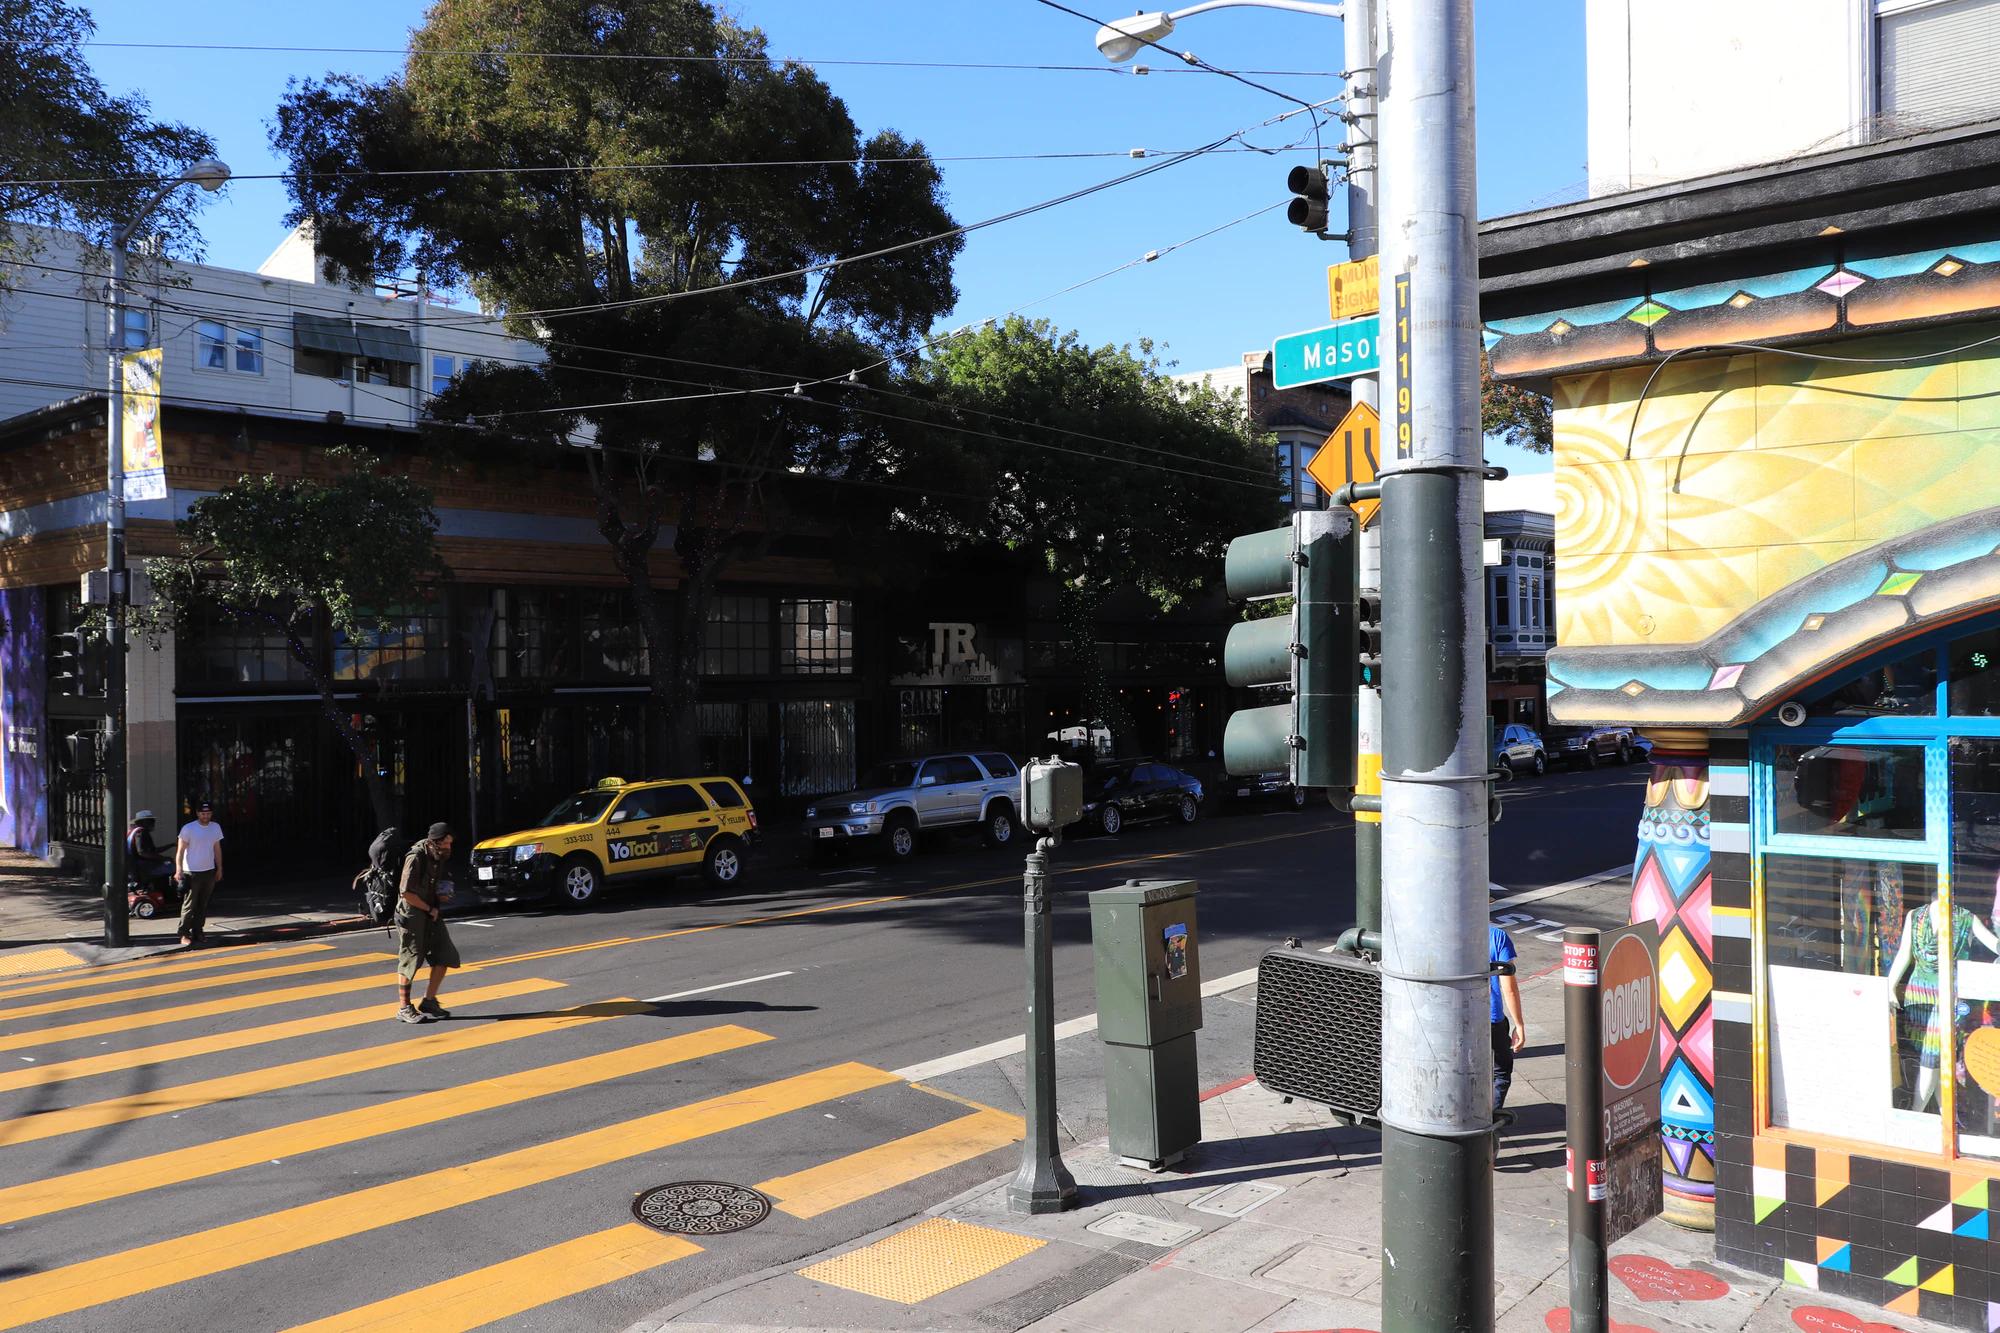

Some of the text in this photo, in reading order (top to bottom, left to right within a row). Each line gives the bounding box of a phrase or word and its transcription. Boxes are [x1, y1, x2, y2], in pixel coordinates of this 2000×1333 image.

[1343, 262, 1379, 284] MUNI
[1335, 289, 1379, 310] SIGNA
[1397, 281, 1411, 450] T1199
[727, 816, 746, 824] YELLOW
[606, 828, 620, 836] 444
[609, 840, 659, 859] YoTaxi
[1564, 945, 1597, 957] STOP ID
[1567, 957, 1594, 968] 15712
[1613, 1096, 1634, 1113] MASONIC
[1604, 1108, 1611, 1144] 3
[1647, 1265, 1673, 1277] THE
